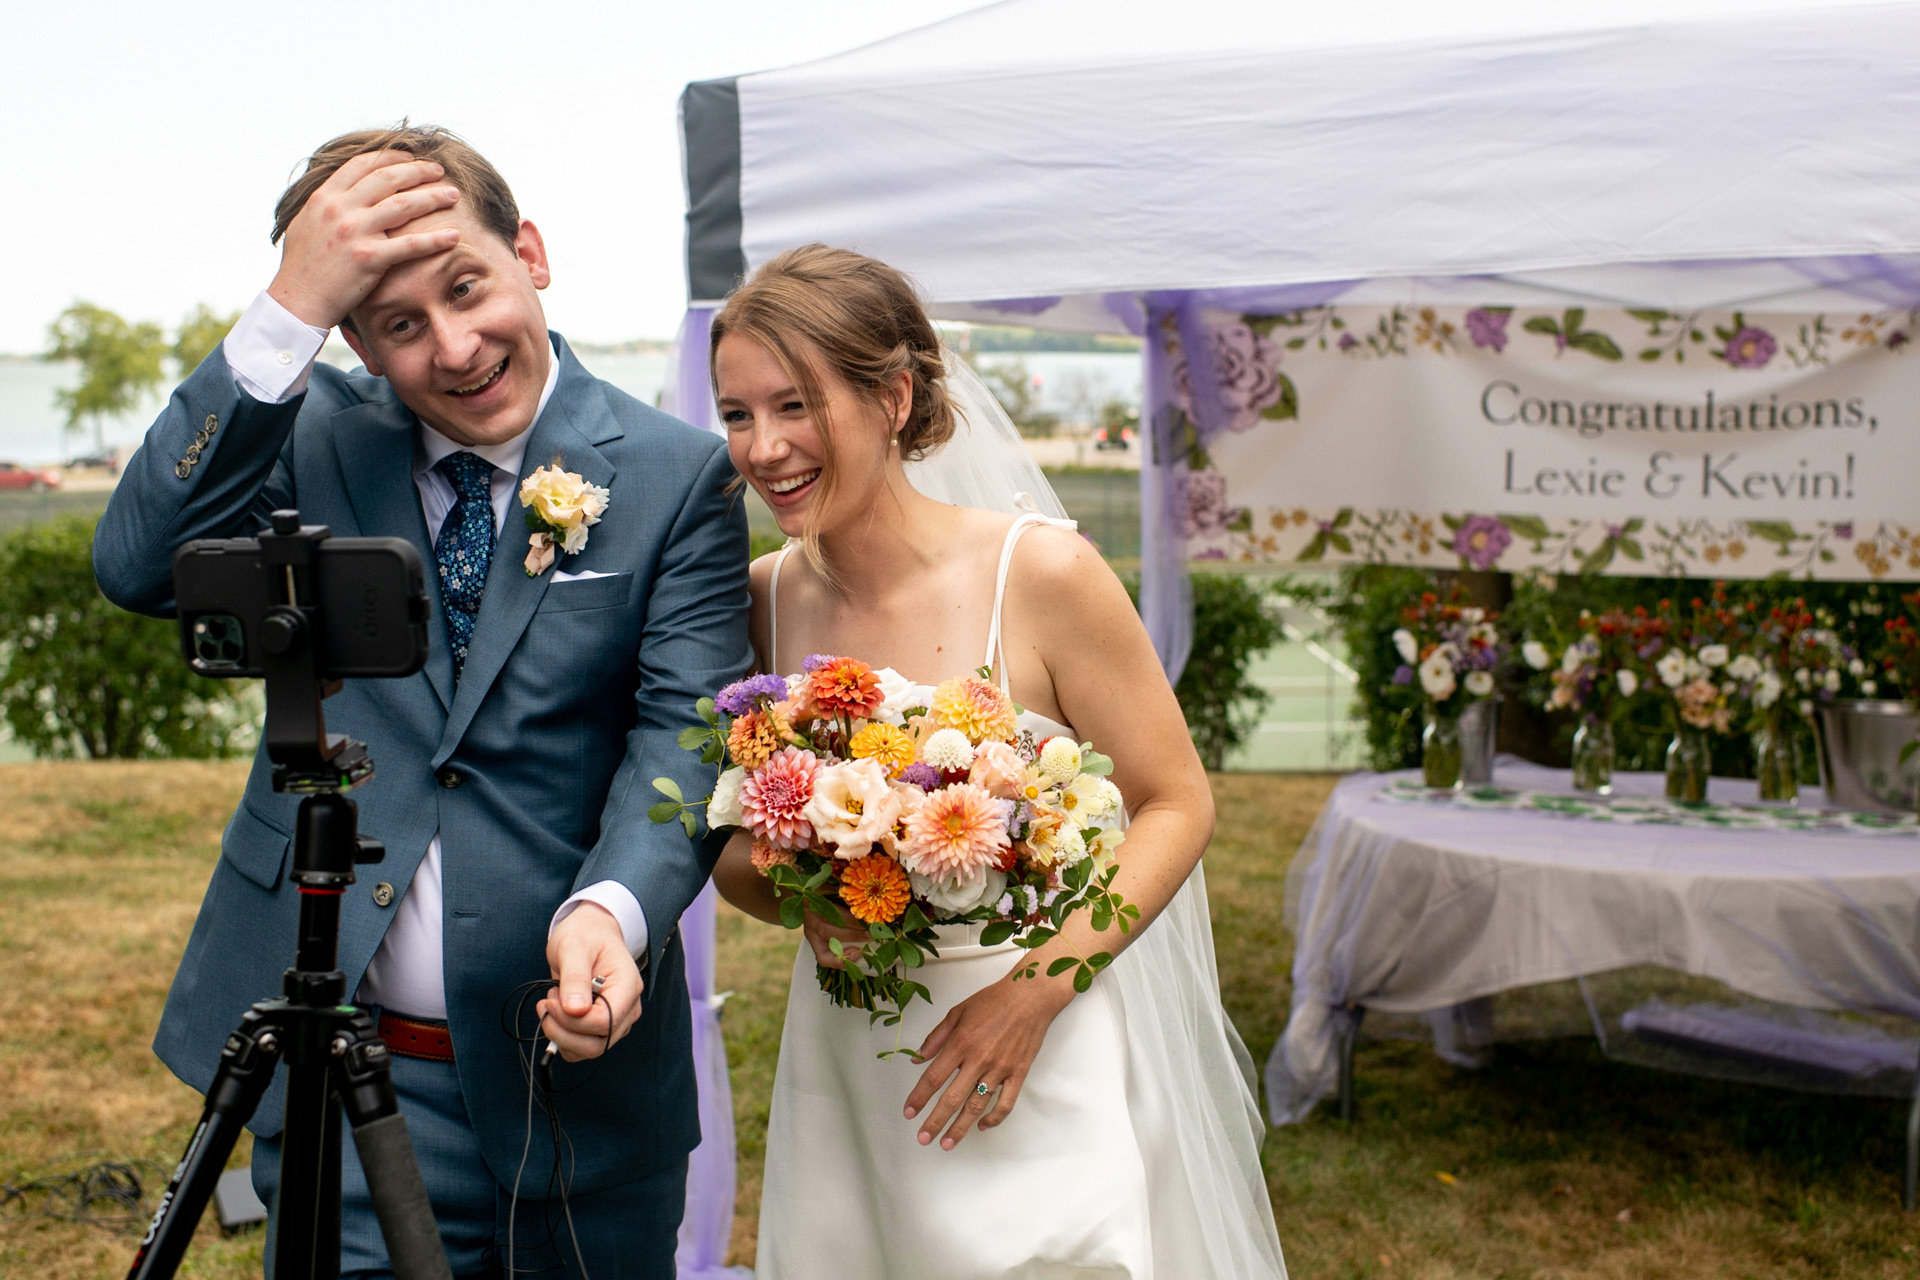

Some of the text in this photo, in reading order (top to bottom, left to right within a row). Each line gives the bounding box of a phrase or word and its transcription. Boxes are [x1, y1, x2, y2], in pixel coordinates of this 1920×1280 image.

[1480, 381, 1879, 437] Congratulations,
[1504, 450, 1855, 500] Lexie & Kevin!
